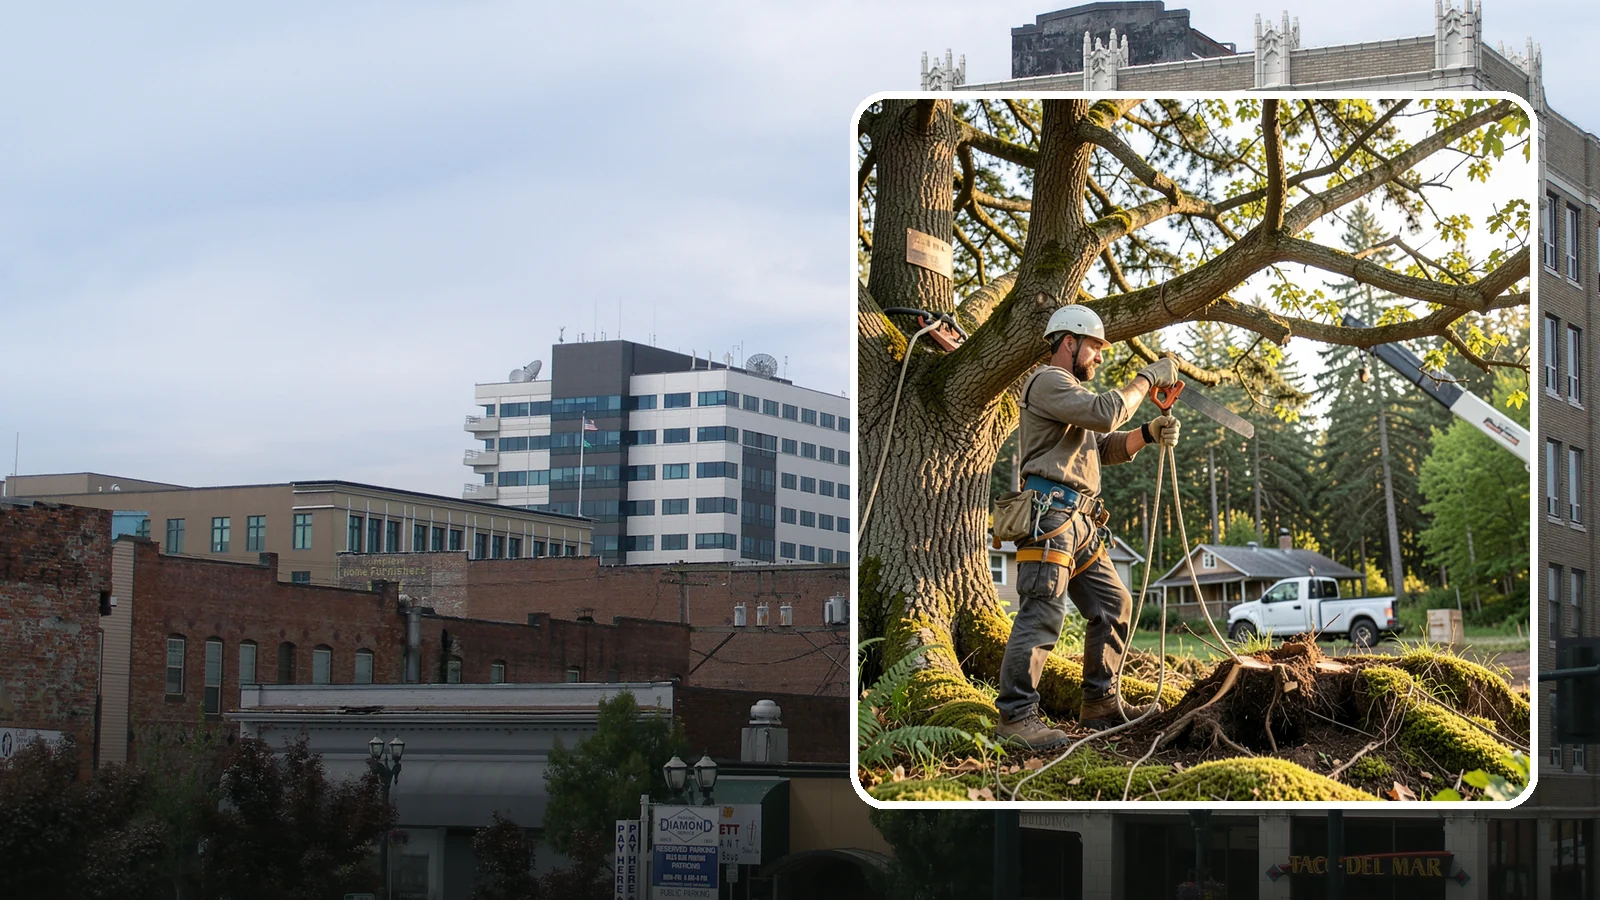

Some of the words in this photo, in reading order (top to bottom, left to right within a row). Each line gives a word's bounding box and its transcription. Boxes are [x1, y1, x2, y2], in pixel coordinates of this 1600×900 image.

[343, 567, 367, 576] Home
[370, 566, 426, 576] Furnishers
[660, 818, 713, 833] DIAMOND
[1021, 815, 1070, 828] BUILDING
[617, 825, 625, 853] PAY
[628, 825, 637, 853] PAY
[656, 845, 688, 853] RESERVED
[689, 846, 716, 854] PARKING
[721, 851, 739, 862] Soup
[671, 862, 701, 870] PATRONS
[1346, 856, 1385, 876] DEL
[1392, 857, 1442, 877] MAR
[616, 856, 625, 893] HERE
[627, 856, 636, 893] HERE
[660, 889, 682, 897] PUBLIC
[684, 890, 710, 898] PARKING
